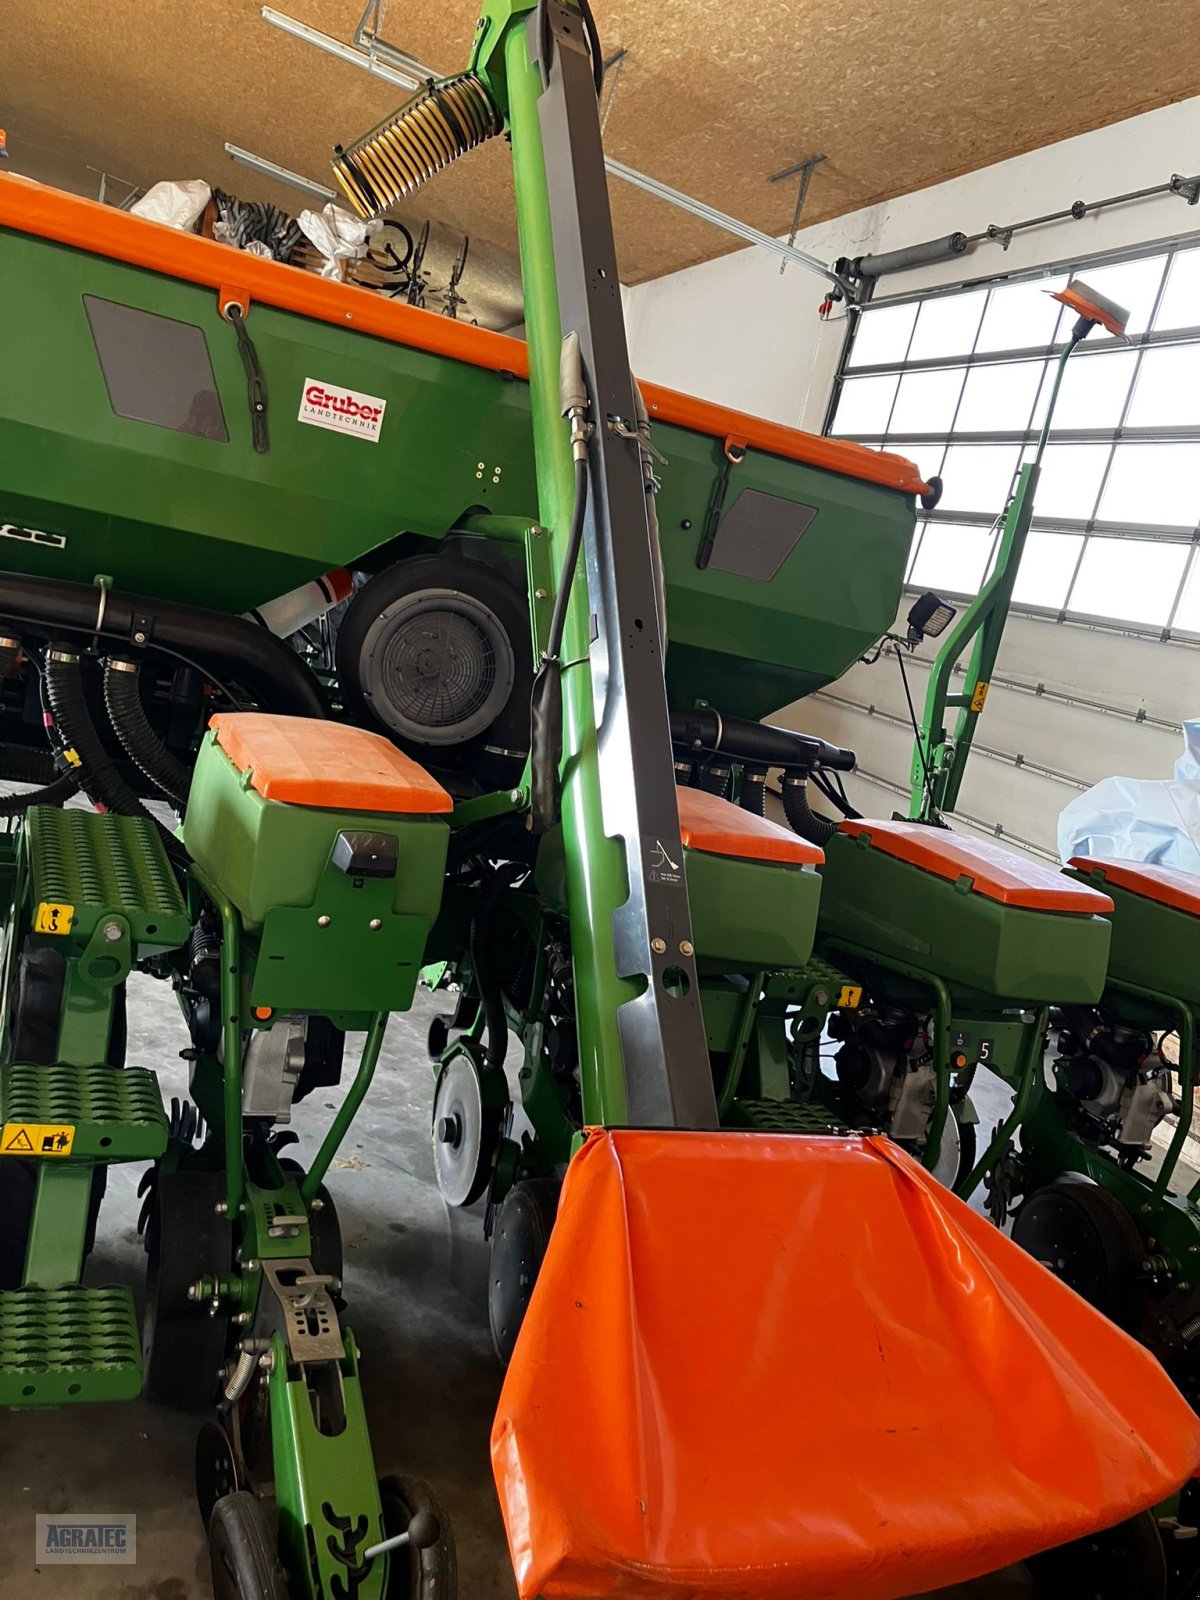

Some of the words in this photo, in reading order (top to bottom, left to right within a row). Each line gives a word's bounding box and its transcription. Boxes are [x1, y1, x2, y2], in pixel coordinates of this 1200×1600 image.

[306, 386, 382, 423] Gruber
[304, 405, 377, 431] LANDTECHNIK
[980, 1042, 990, 1060] 5
